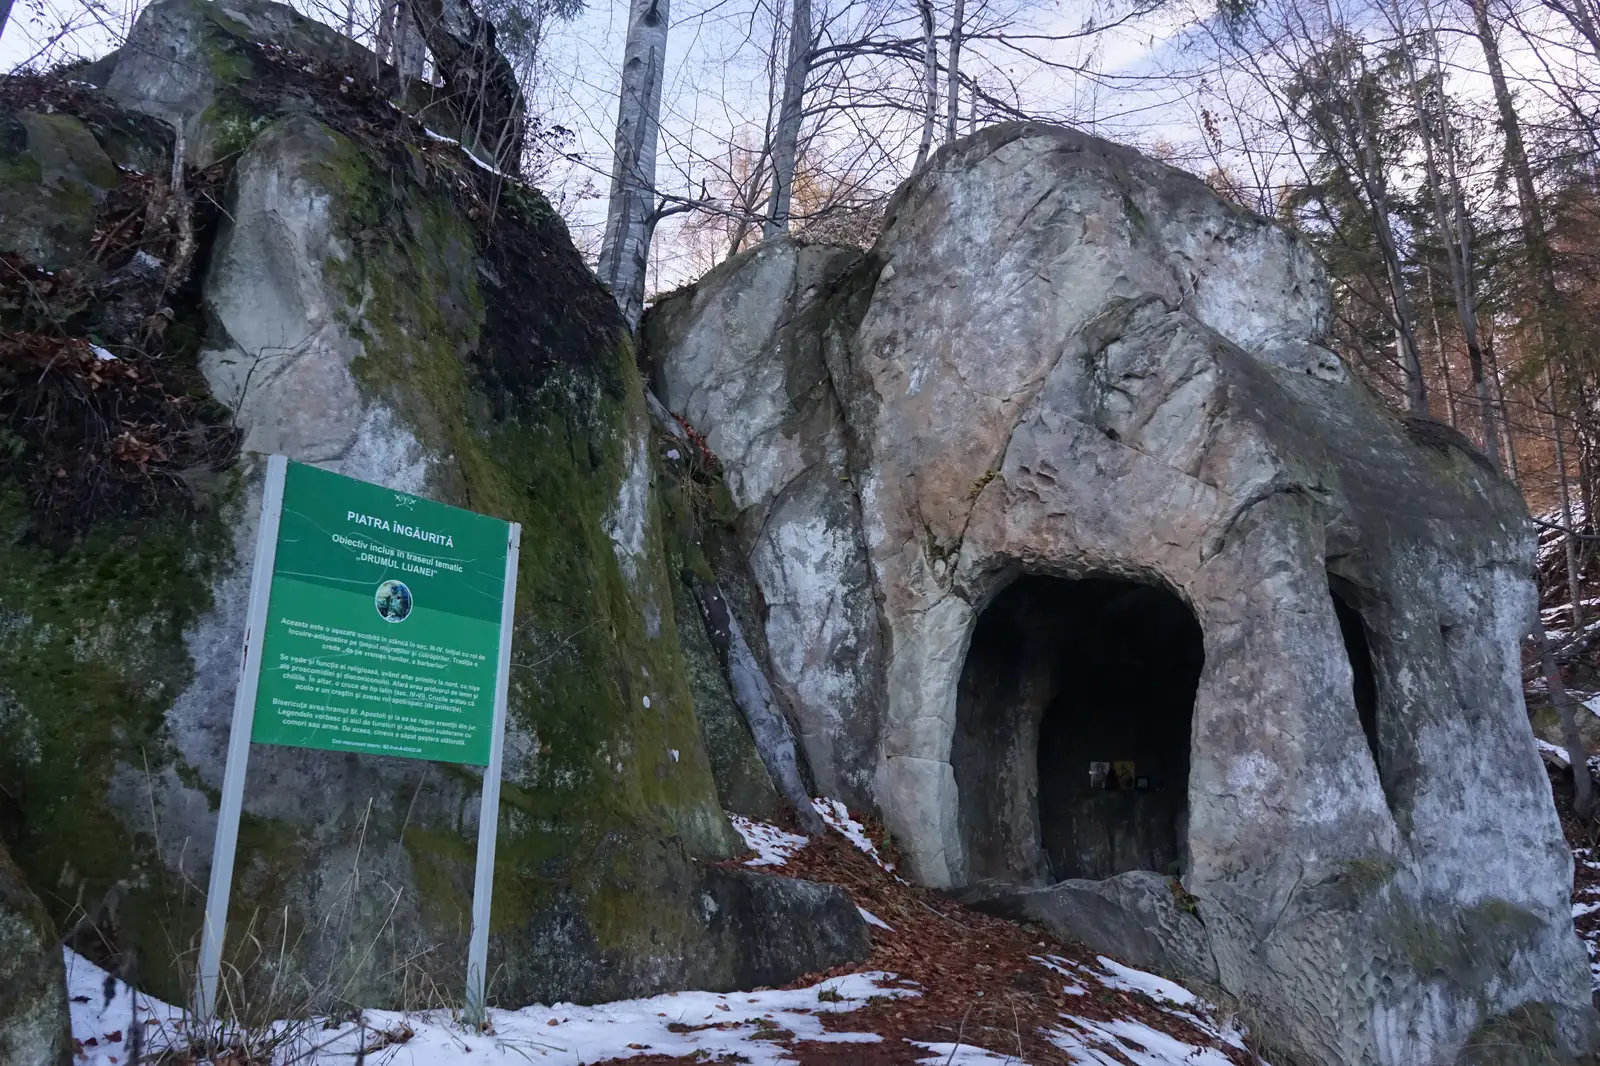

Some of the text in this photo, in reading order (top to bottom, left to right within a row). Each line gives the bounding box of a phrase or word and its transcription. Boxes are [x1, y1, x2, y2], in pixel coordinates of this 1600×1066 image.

[348, 511, 454, 547] PIATRA ÎNGĂURITĂ
[332, 534, 463, 573] Obiectiv inclus în traseul tematic
[281, 618, 309, 628] Aceasta
[332, 628, 357, 637] așezare
[357, 633, 380, 641] scobită
[388, 638, 409, 646] stâncă
[359, 641, 379, 650] timpul
[316, 660, 339, 669] funcția
[424, 686, 450, 694] pridvorul
[278, 708, 313, 718] Legendele
[325, 705, 349, 714] hramul
[360, 710, 387, 719] Apostoli
